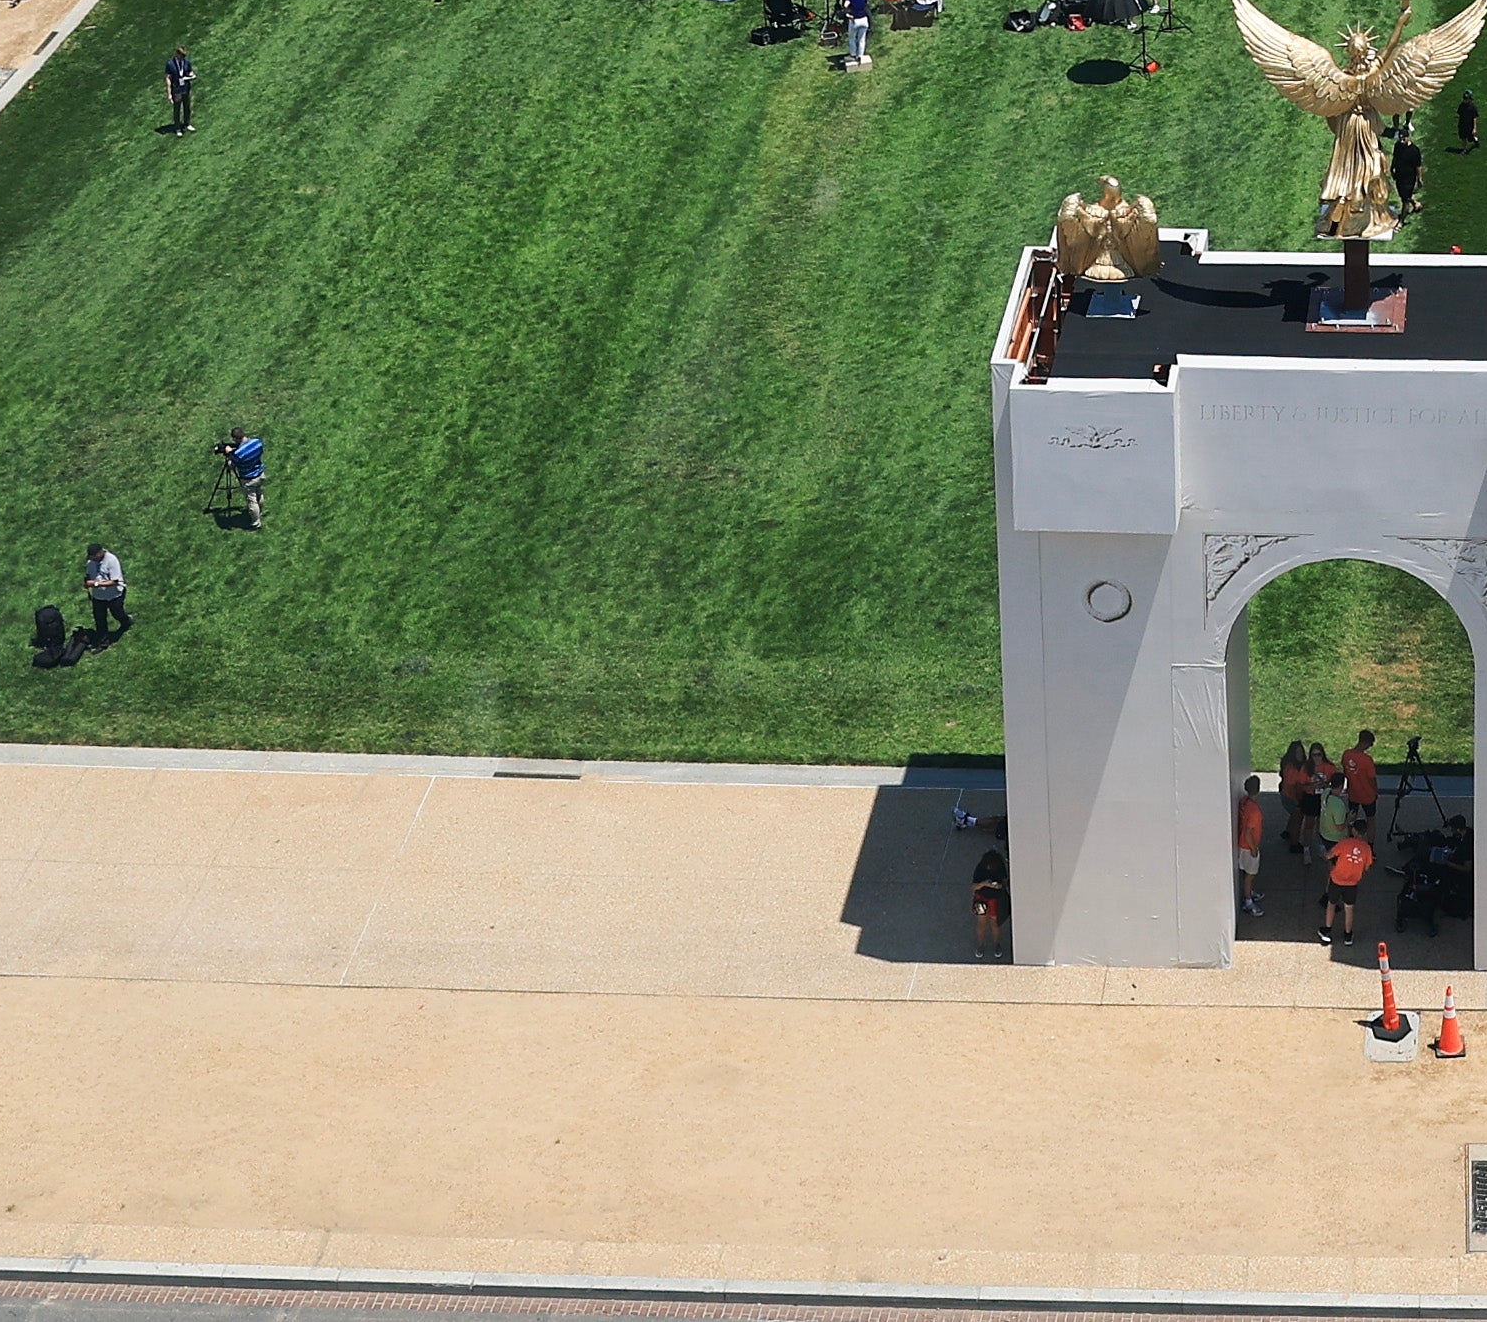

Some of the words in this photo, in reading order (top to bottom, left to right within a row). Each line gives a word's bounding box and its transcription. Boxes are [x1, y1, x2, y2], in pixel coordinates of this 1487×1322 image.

[1200, 404, 1286, 422] LIBERTY
[1316, 406, 1398, 425] JUSTICE
[1409, 407, 1449, 425] FOR
